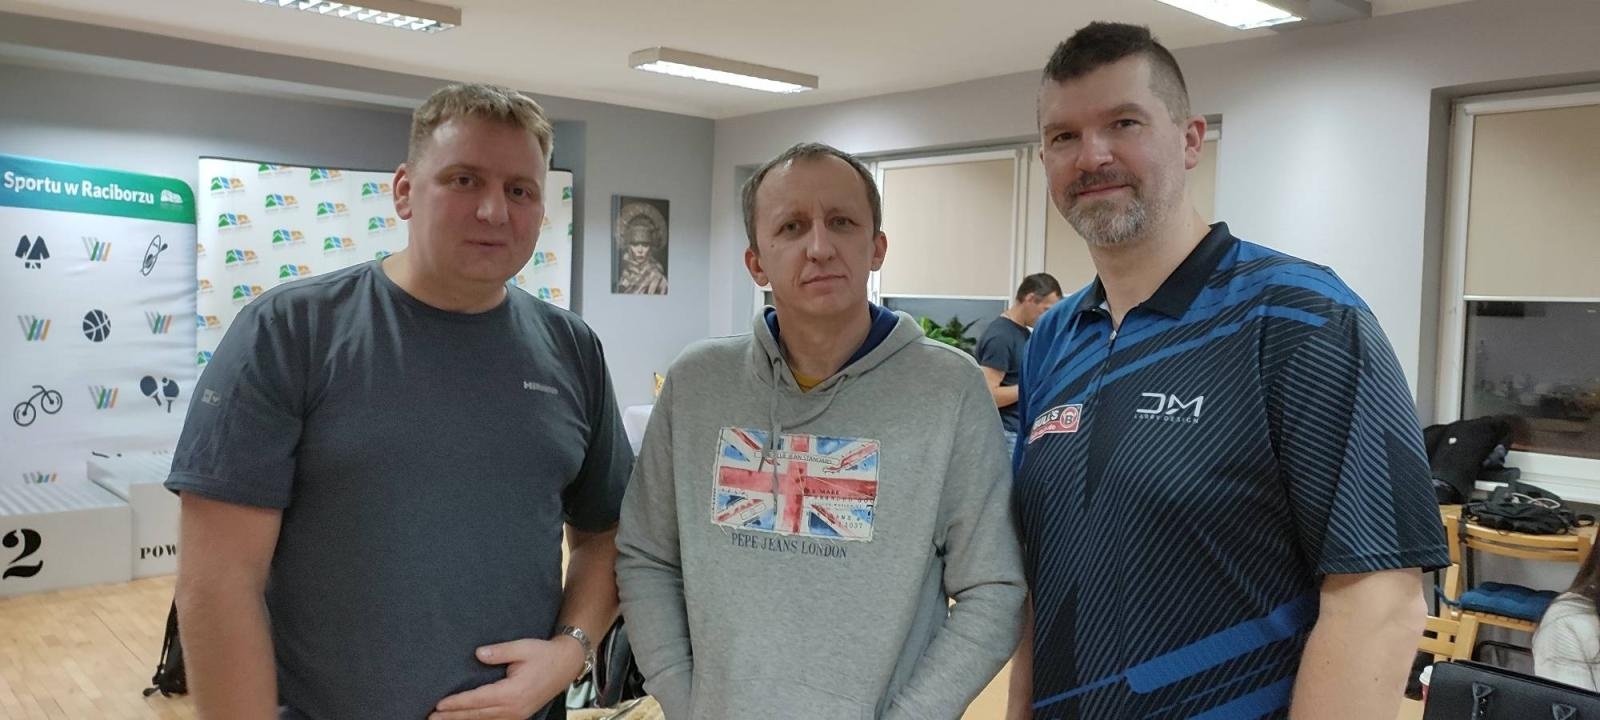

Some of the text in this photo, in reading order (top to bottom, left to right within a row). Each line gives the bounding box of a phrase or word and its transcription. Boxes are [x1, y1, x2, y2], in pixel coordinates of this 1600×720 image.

[4, 171, 154, 204] Sportu w Raciborzu
[2, 528, 43, 579] 2
[731, 533, 848, 559] PEPE JEANS LONDON
